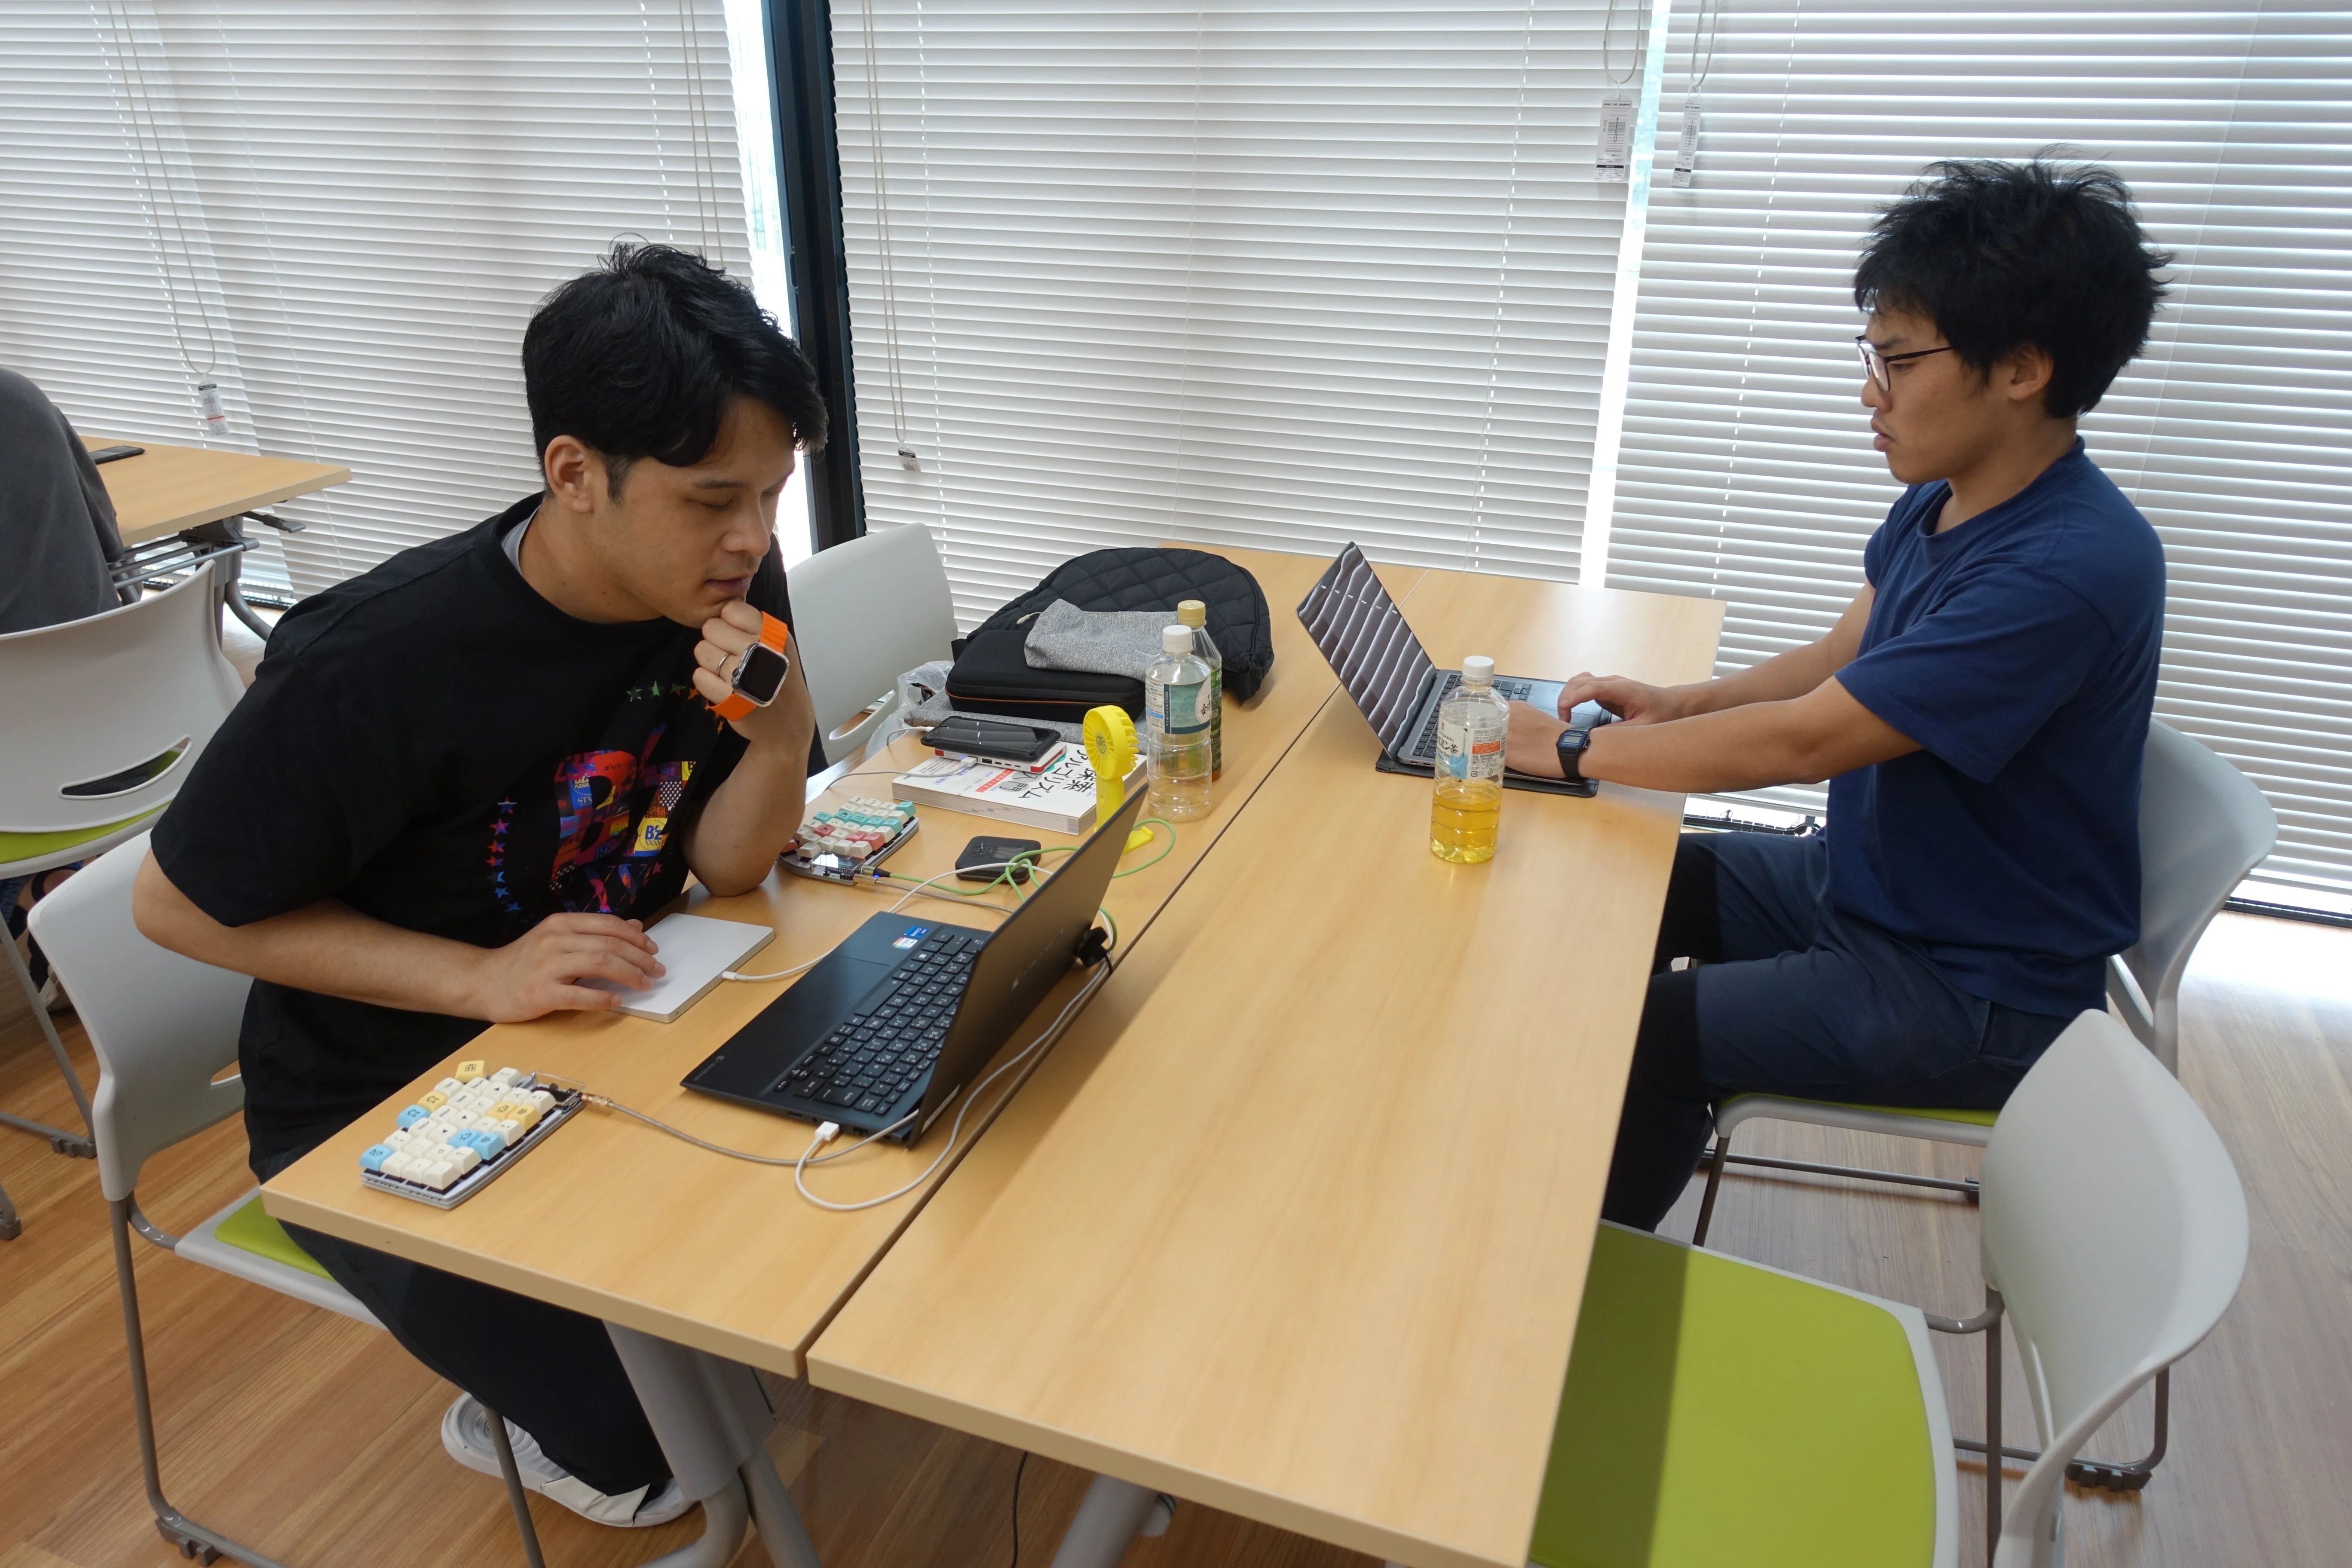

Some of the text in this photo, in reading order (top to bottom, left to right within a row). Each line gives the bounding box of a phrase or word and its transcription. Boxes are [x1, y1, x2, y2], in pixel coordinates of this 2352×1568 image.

[1018, 749, 1088, 798] アルゴリズム
[1063, 768, 1097, 793] 探索
[645, 825, 662, 840] B'z
